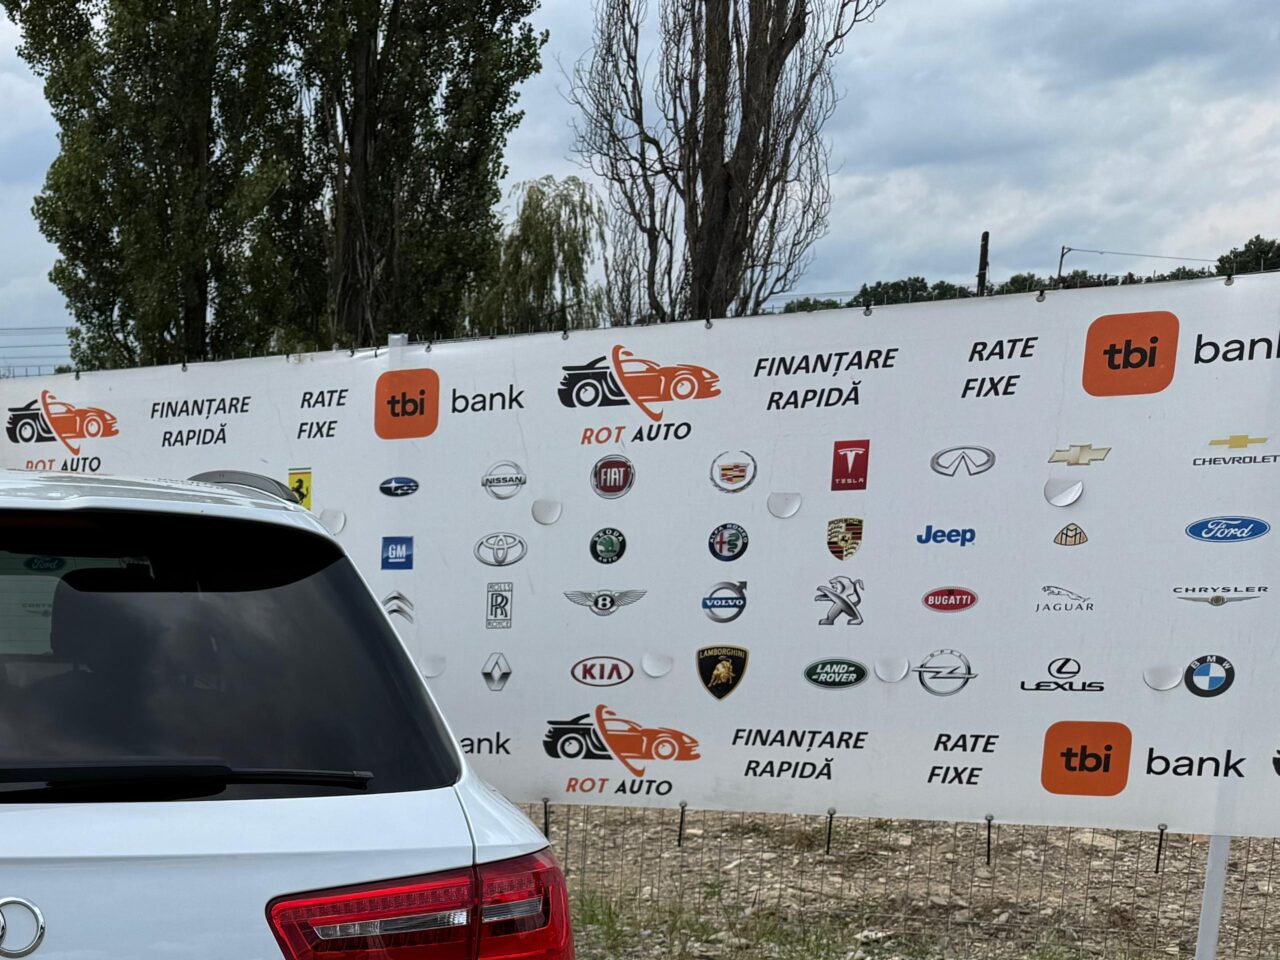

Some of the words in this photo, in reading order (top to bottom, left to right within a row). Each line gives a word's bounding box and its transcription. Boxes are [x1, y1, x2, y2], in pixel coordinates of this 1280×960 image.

[968, 336, 1038, 362] RATE
[1103, 336, 1159, 370] tbi
[1194, 331, 1280, 364] ban
[754, 348, 900, 380] FINANȚARE
[767, 381, 860, 411] RAPIDĂ
[961, 375, 1021, 398] FIXE
[150, 396, 251, 419] FINANȚARE
[301, 388, 349, 409] RATE
[387, 390, 426, 418] tbi
[451, 384, 525, 413] bank
[161, 424, 227, 448] RAPIDĂ
[297, 420, 338, 440] FIXE
[581, 425, 625, 445] ROT
[631, 422, 692, 443] AUTO
[61, 457, 101, 472] AUTO
[1193, 455, 1280, 466] CHEVROLET
[486, 475, 522, 484] NISSAN
[600, 467, 626, 487] FIAT
[916, 525, 976, 547] Jeep
[1201, 520, 1255, 538] Ford
[388, 544, 406, 558] GM
[928, 595, 971, 605] BUGATTI
[1173, 586, 1269, 594] CHRYSLER
[705, 599, 744, 607] VOLVO
[1035, 603, 1094, 613] JAGUAR
[699, 648, 745, 659] LAMBORGHINI
[1190, 655, 1232, 670] BMW
[582, 663, 623, 680] KIA
[1020, 681, 1105, 692] LEXUS
[460, 732, 511, 755] ank
[731, 728, 868, 754] FINANȚARE
[934, 734, 999, 753] RATE
[744, 757, 833, 781] RAPIDĂ
[1060, 745, 1112, 773] tbi
[1146, 747, 1246, 779] bank
[928, 767, 982, 785] FIXE
[565, 778, 609, 794] ROT
[614, 779, 673, 796] AUTO
